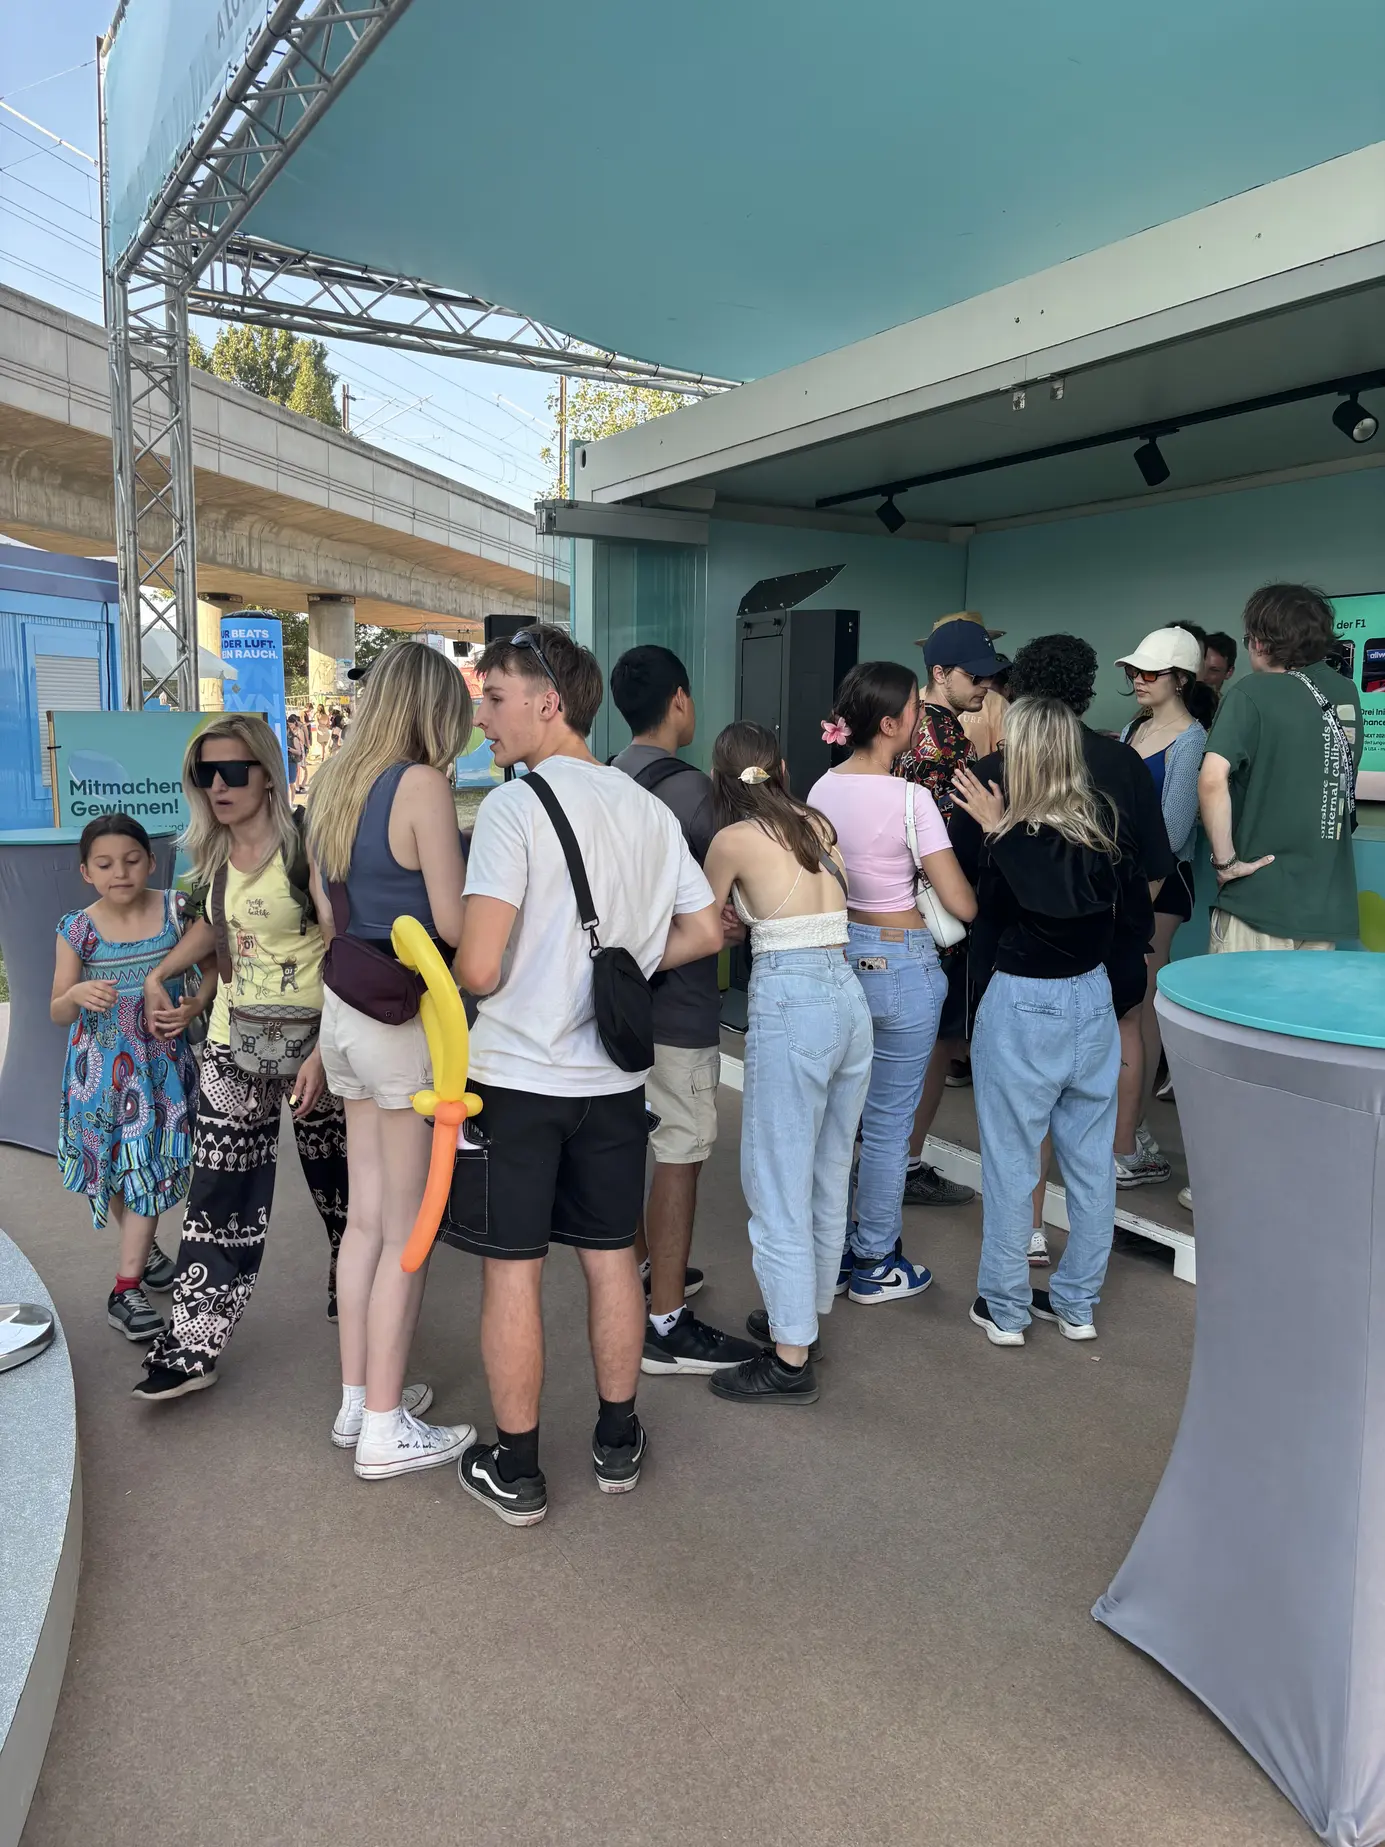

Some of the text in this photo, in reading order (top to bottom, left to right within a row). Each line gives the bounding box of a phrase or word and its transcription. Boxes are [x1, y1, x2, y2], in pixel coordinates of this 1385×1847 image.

[1336, 619, 1366, 629] der F1
[231, 629, 269, 638] BEATS
[224, 640, 241, 649] DER
[244, 639, 276, 649] LUFT.
[235, 650, 278, 659] RAUCH.
[1322, 725, 1331, 774] sounds
[69, 778, 183, 796] Mitmachen
[71, 799, 179, 816] Gewinnen!
[1326, 782, 1339, 840] internal
